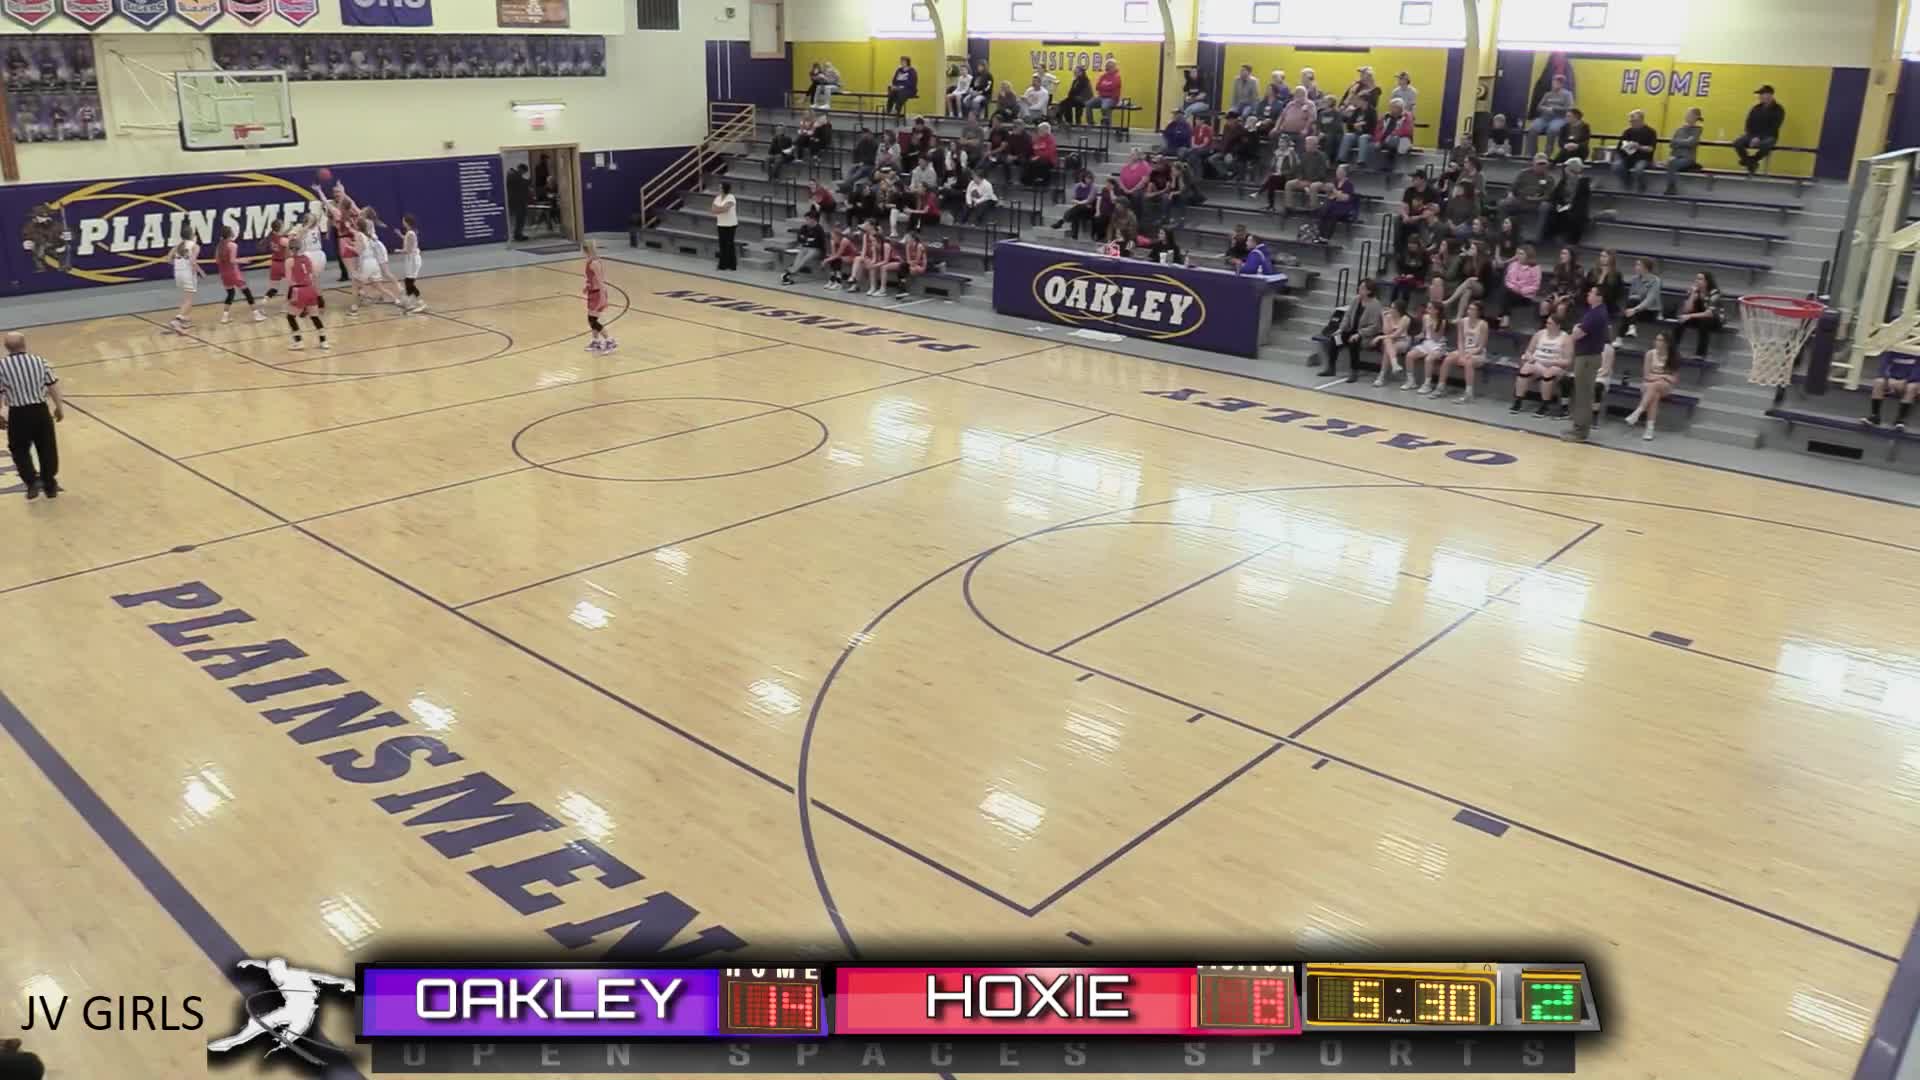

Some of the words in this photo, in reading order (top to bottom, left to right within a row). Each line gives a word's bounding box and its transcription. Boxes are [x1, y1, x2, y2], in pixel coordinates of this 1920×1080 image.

[1621, 69, 1712, 97] HOME
[653, 290, 981, 352] PLAINSMEN
[1044, 276, 1193, 325] OAKLEY
[1140, 388, 1518, 465] OAKLEY
[110, 580, 748, 960] PLAINSMEN
